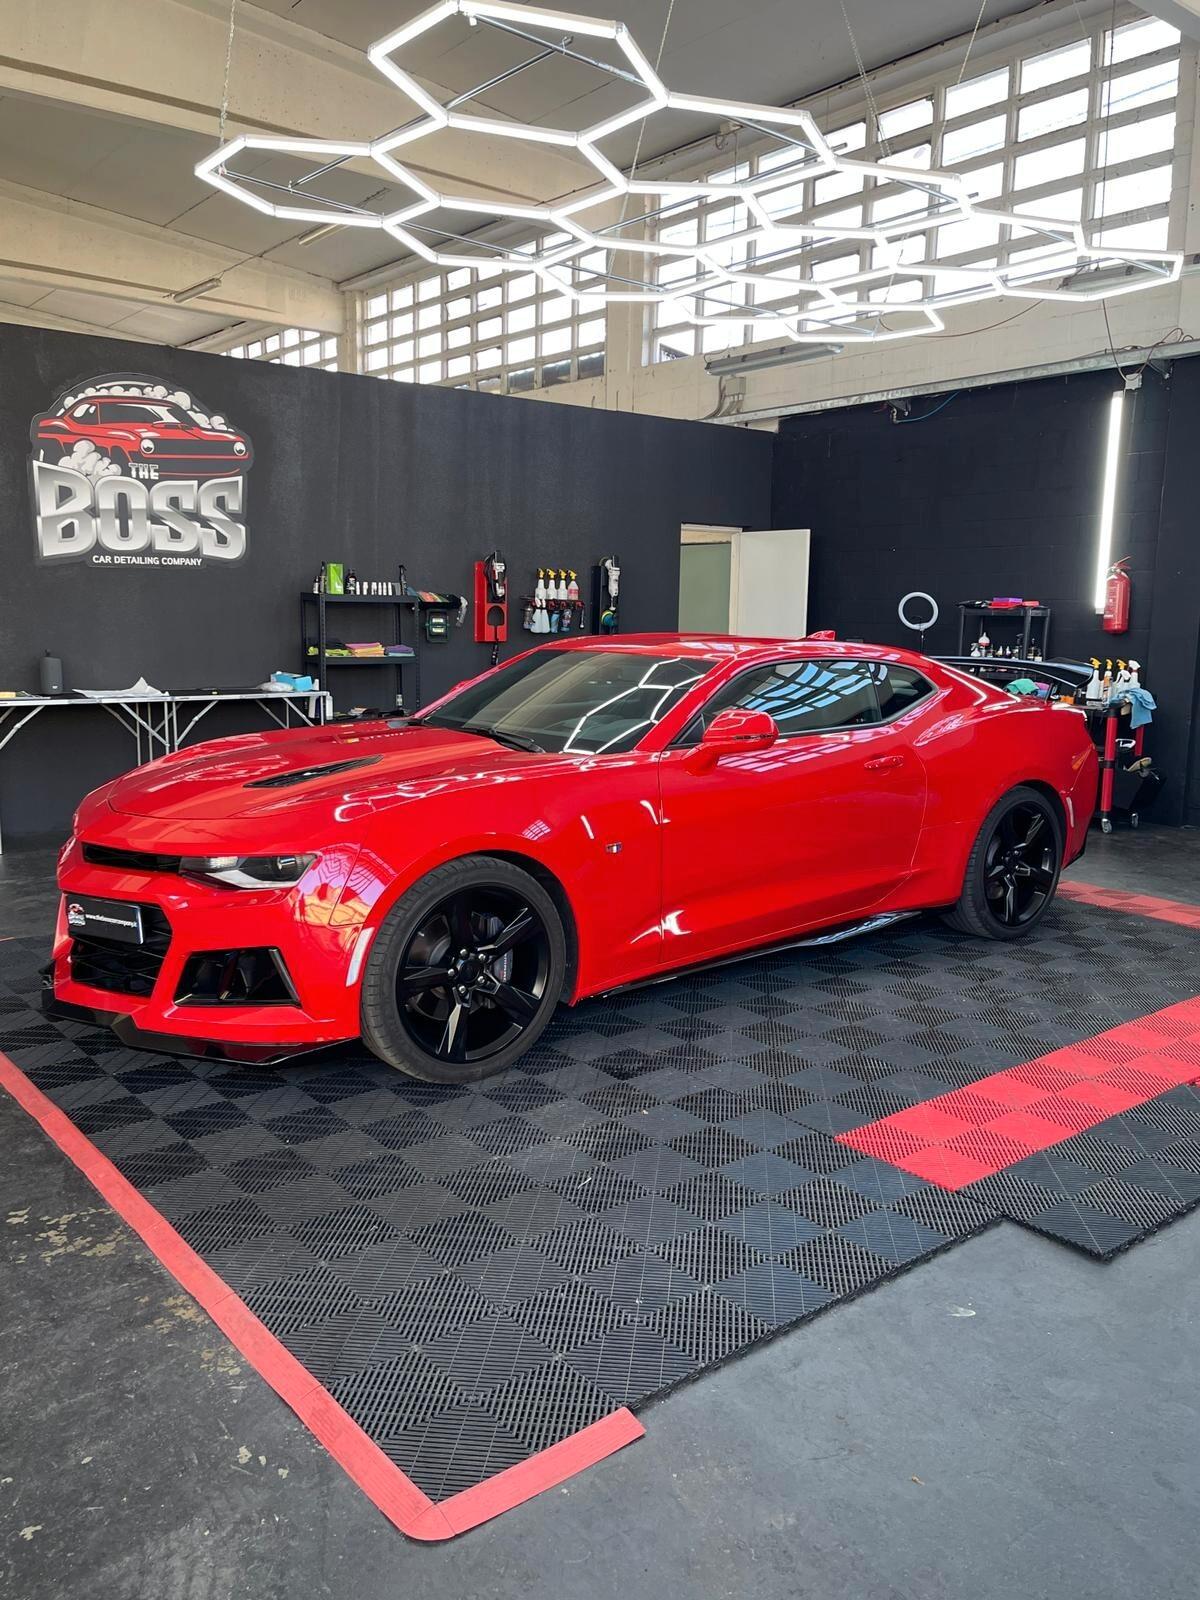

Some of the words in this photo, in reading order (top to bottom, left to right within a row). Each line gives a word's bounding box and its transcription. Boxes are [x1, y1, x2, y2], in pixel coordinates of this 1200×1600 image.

[128, 462, 160, 480] THE
[32, 459, 247, 560] BOSS
[92, 555, 112, 564] CAR
[114, 556, 159, 565] DETAILING
[161, 557, 202, 566] COMPANY
